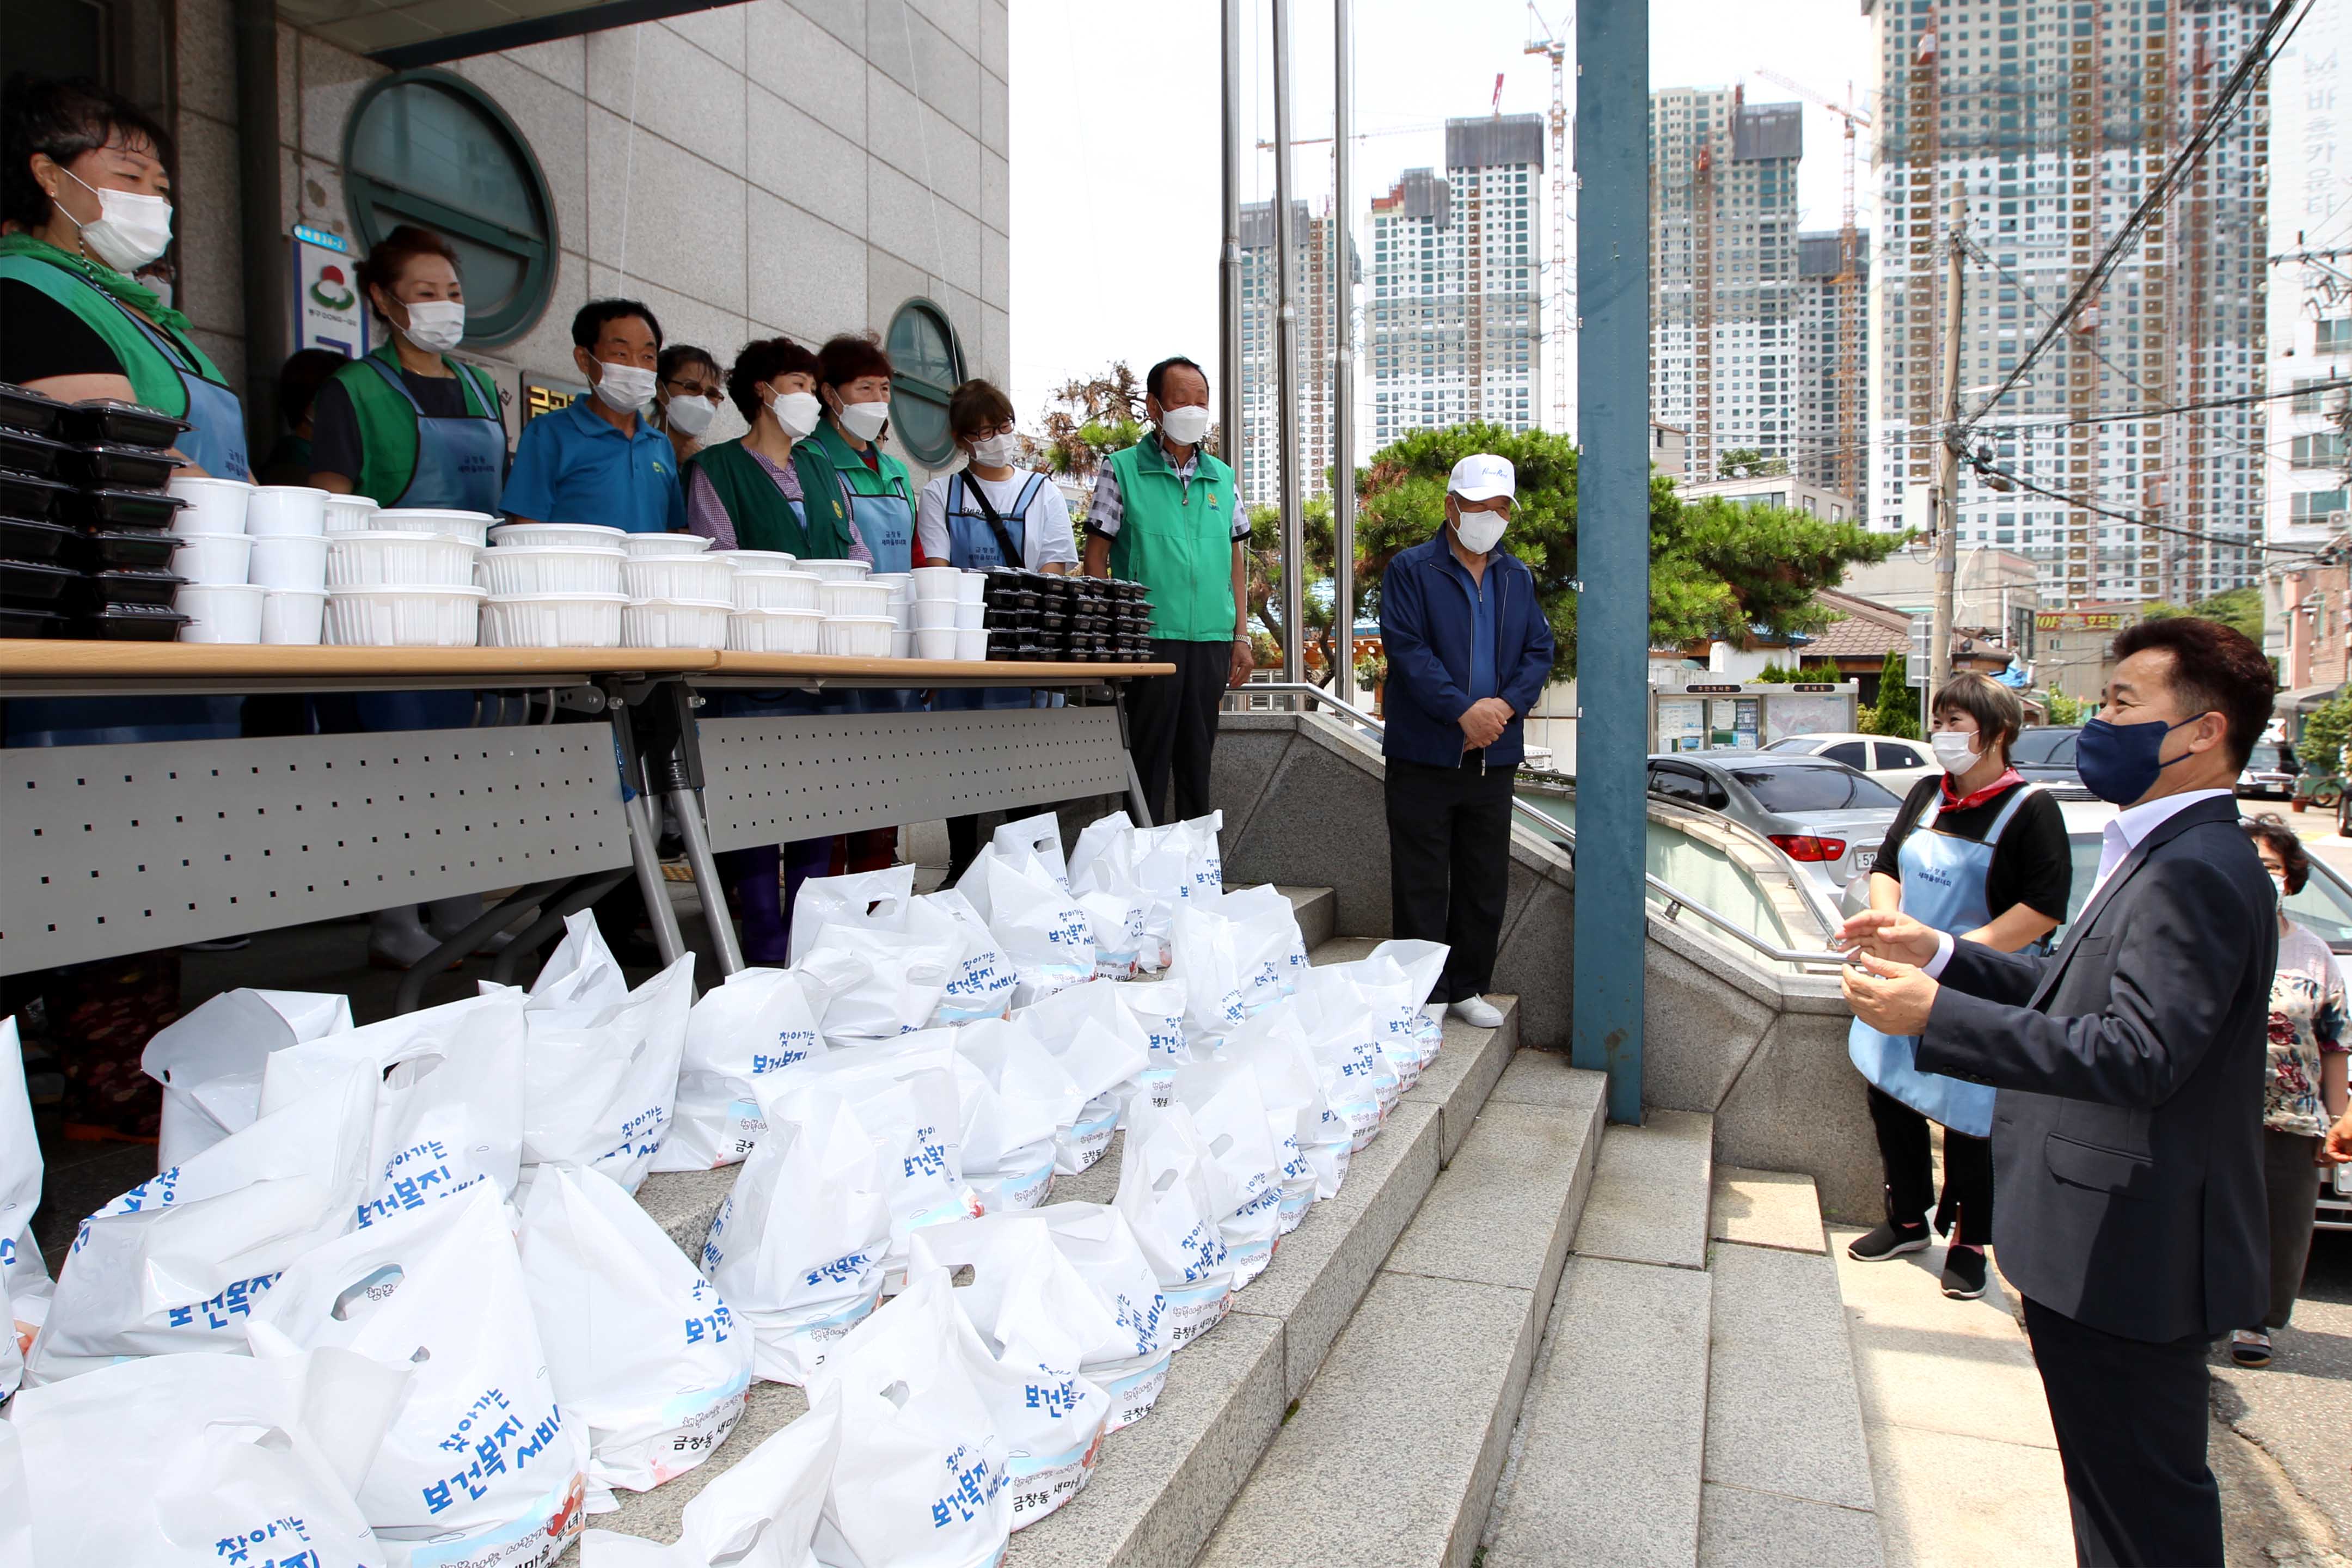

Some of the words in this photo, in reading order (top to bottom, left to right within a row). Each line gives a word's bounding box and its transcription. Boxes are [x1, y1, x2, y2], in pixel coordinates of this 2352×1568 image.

[1049, 923, 1087, 945] 보건복지
[962, 951, 995, 972] 찾아가는
[946, 966, 995, 995] 보건복지
[989, 972, 1021, 991] 서비스
[779, 1030, 816, 1047] 찾아가는
[621, 1105, 664, 1140] 찾아가는
[384, 1141, 448, 1182] 찾아가는
[357, 1165, 451, 1230] 보건복지
[1173, 1324, 1198, 1339] 금창동
[438, 1388, 510, 1454] 찾아가는
[673, 1430, 714, 1450] 금창동
[422, 1413, 524, 1515] 보건복지
[932, 1458, 989, 1529] 보건복지
[1013, 1490, 1050, 1512] 금창동
[216, 1516, 311, 1560] 찾아가는
